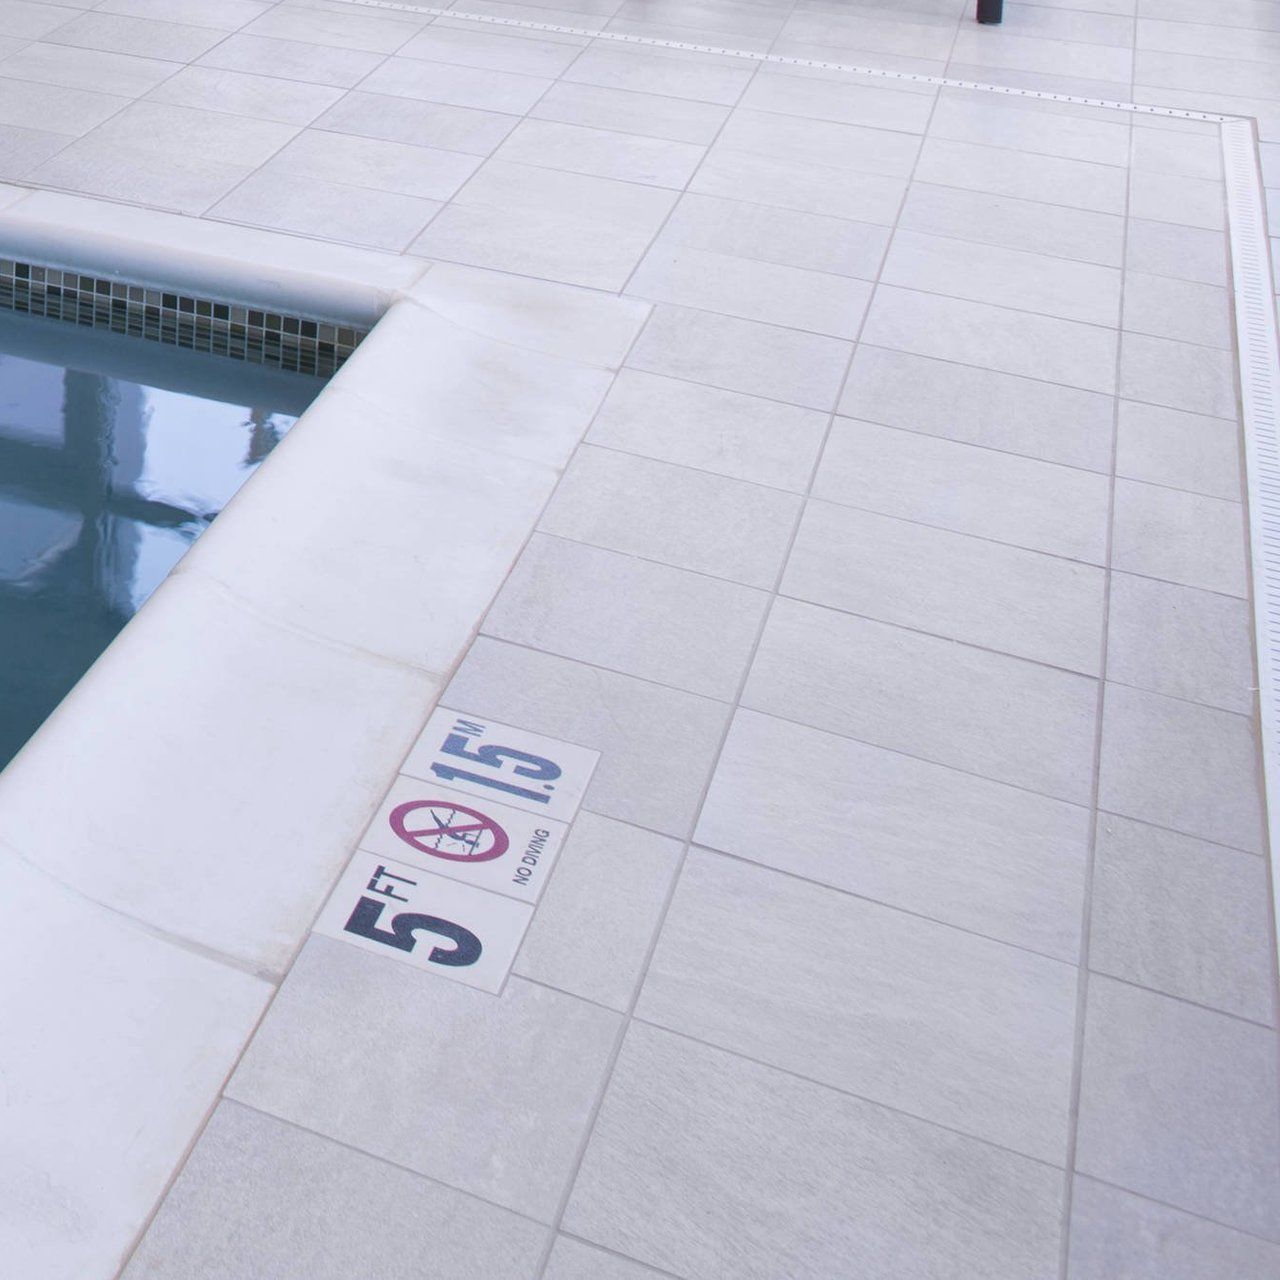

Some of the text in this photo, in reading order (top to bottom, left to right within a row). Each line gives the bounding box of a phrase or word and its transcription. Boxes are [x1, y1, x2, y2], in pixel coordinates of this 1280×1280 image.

[430, 733, 562, 805] 1.5
[511, 828, 550, 887] NO DIVING
[343, 865, 483, 967] 5 FT
